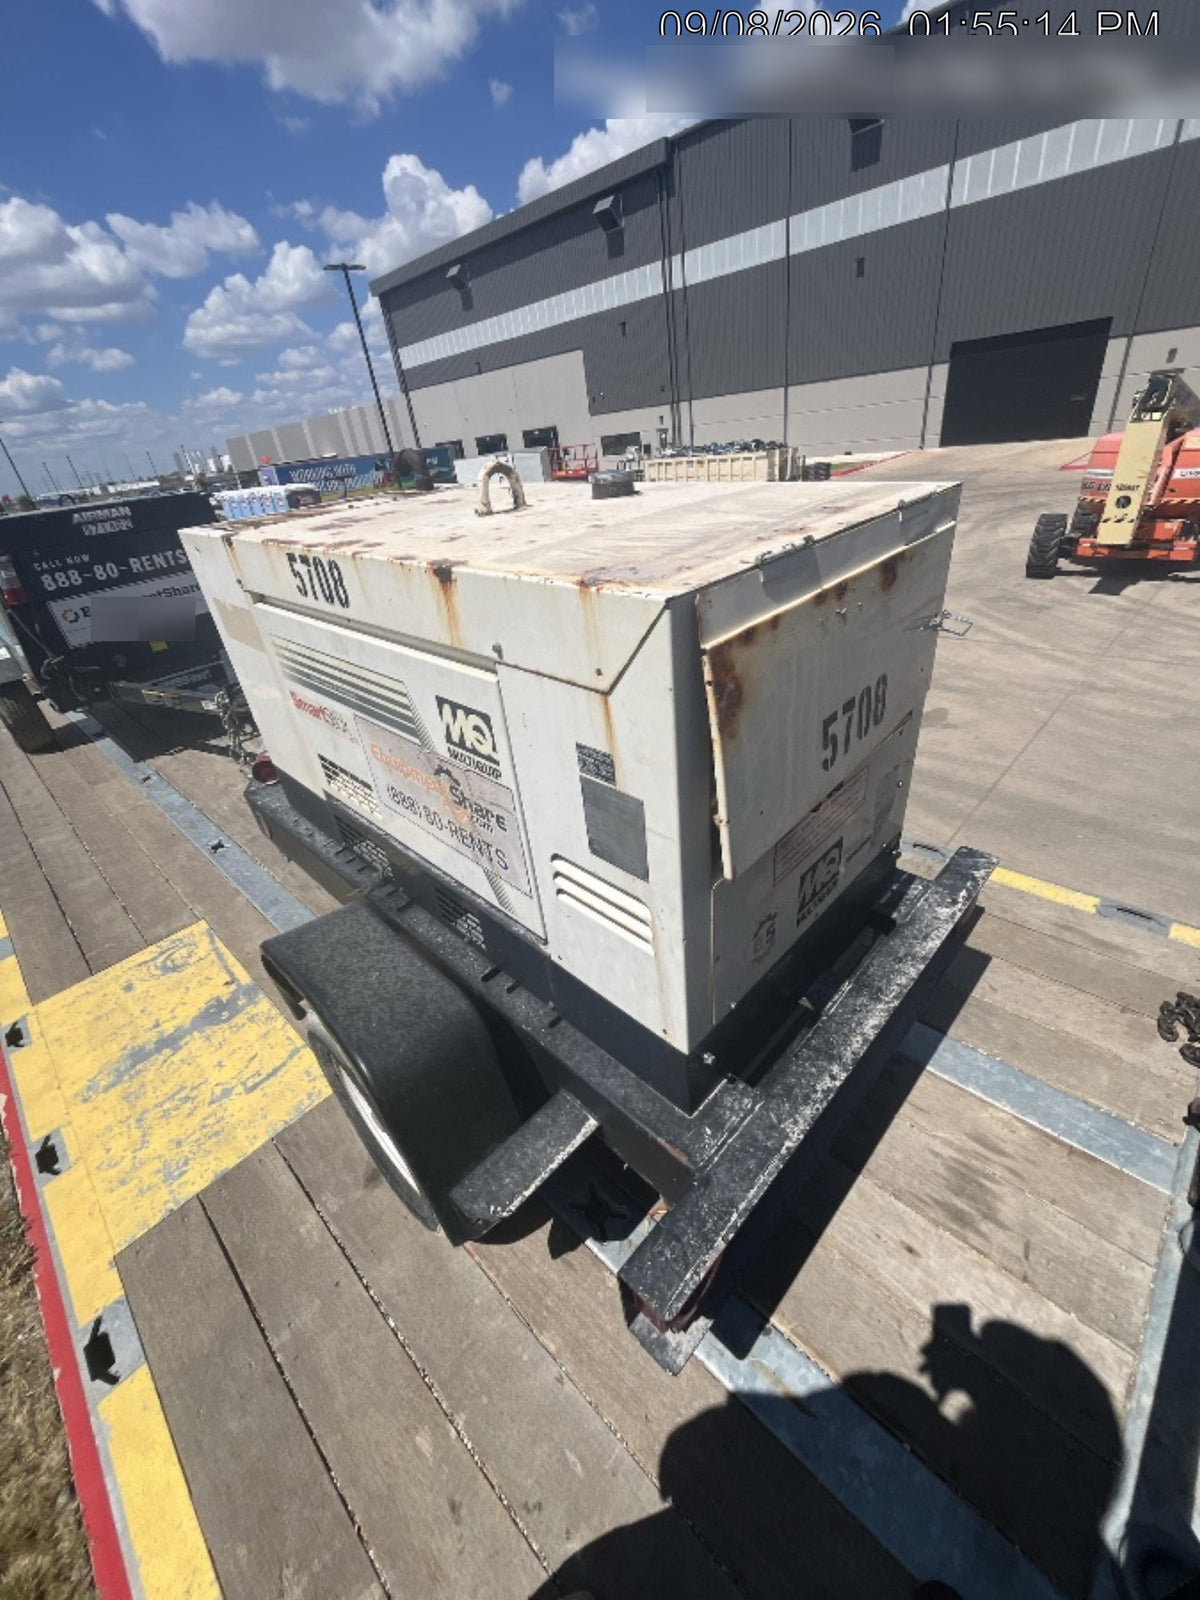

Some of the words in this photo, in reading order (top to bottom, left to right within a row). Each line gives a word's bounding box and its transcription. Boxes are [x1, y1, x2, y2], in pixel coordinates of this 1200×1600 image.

[72, 506, 132, 525] AIRMAN
[40, 548, 188, 591] 888-80-RENTS
[286, 552, 350, 608] 5708
[822, 673, 888, 772] 5708
